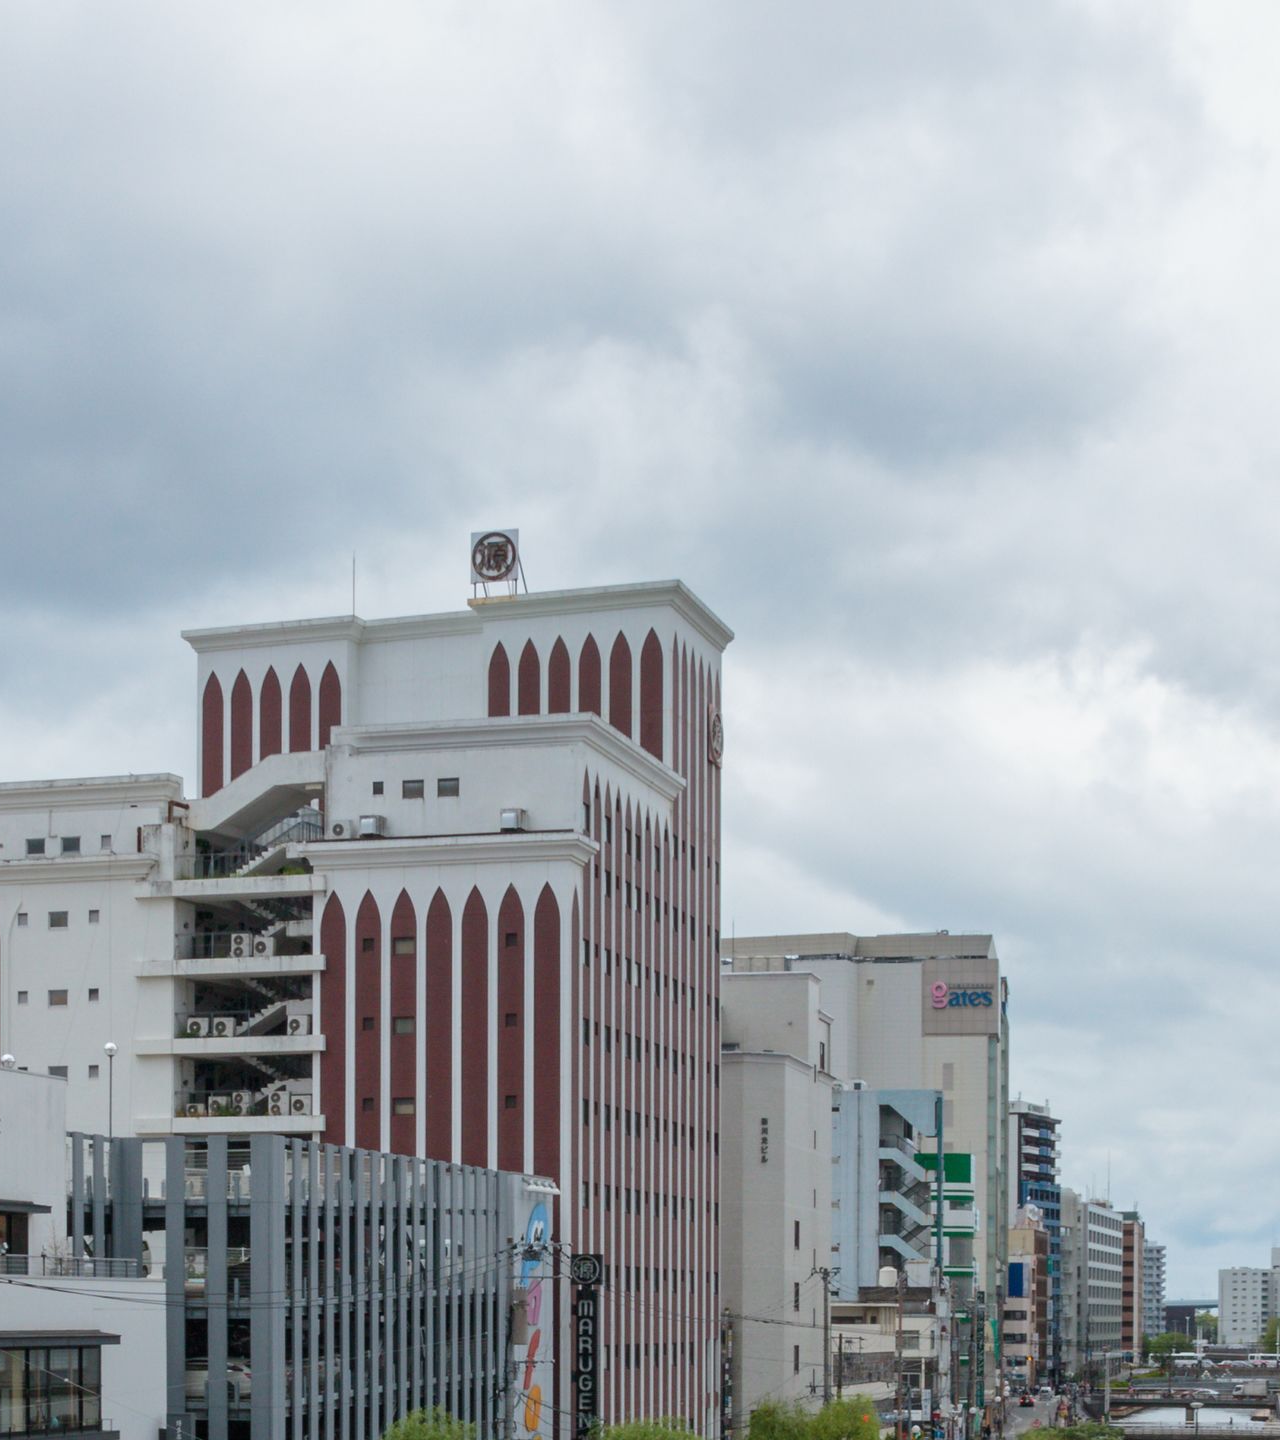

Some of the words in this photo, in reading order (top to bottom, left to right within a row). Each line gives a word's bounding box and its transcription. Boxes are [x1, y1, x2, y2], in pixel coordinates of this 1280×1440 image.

[930, 981, 993, 1009] gates
[573, 1258, 596, 1281] 源
[577, 1299, 593, 1429] MARUGEN
